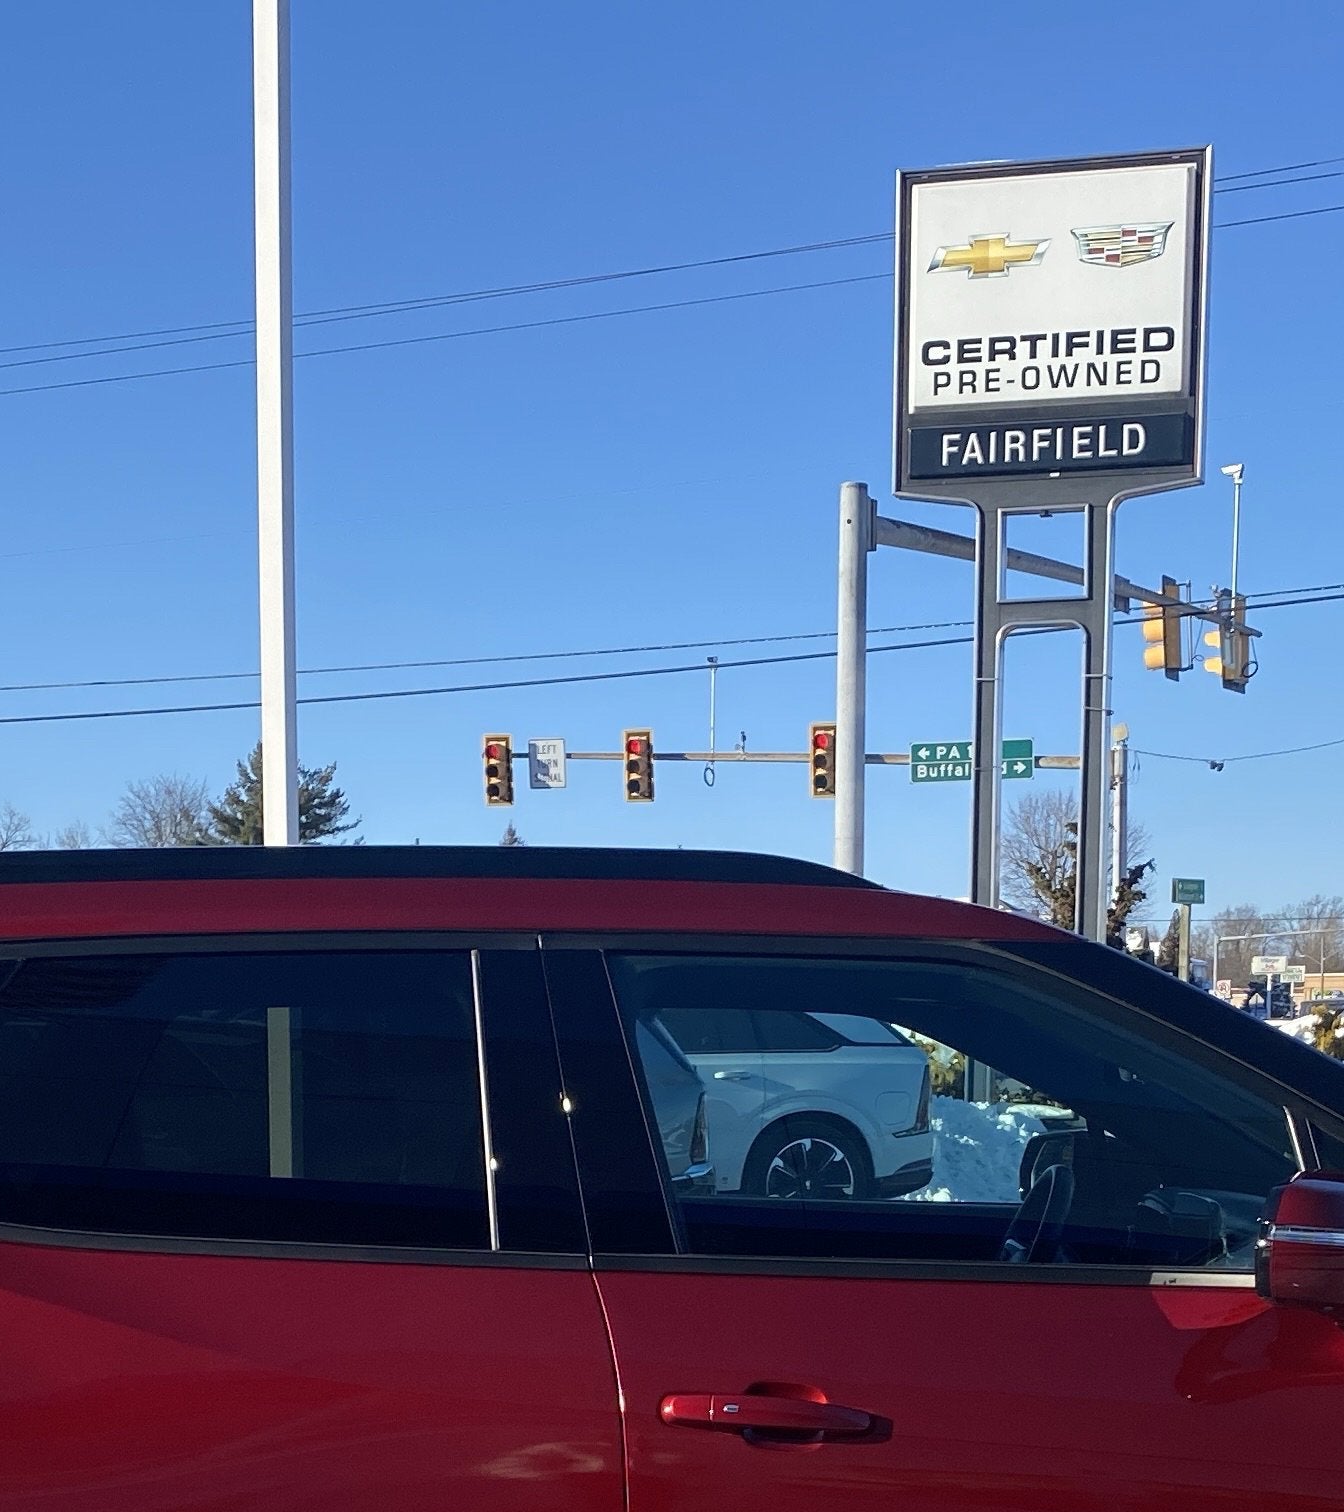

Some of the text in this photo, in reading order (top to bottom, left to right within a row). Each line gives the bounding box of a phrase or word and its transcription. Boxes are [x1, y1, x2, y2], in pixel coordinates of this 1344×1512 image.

[921, 326, 1176, 367] CERTIFIED
[932, 358, 1162, 397] PRE-OWNED
[940, 422, 1147, 467] FAIRFIELD
[536, 744, 557, 755] LEFT
[936, 745, 961, 760] PA
[916, 762, 970, 778] Buffal
